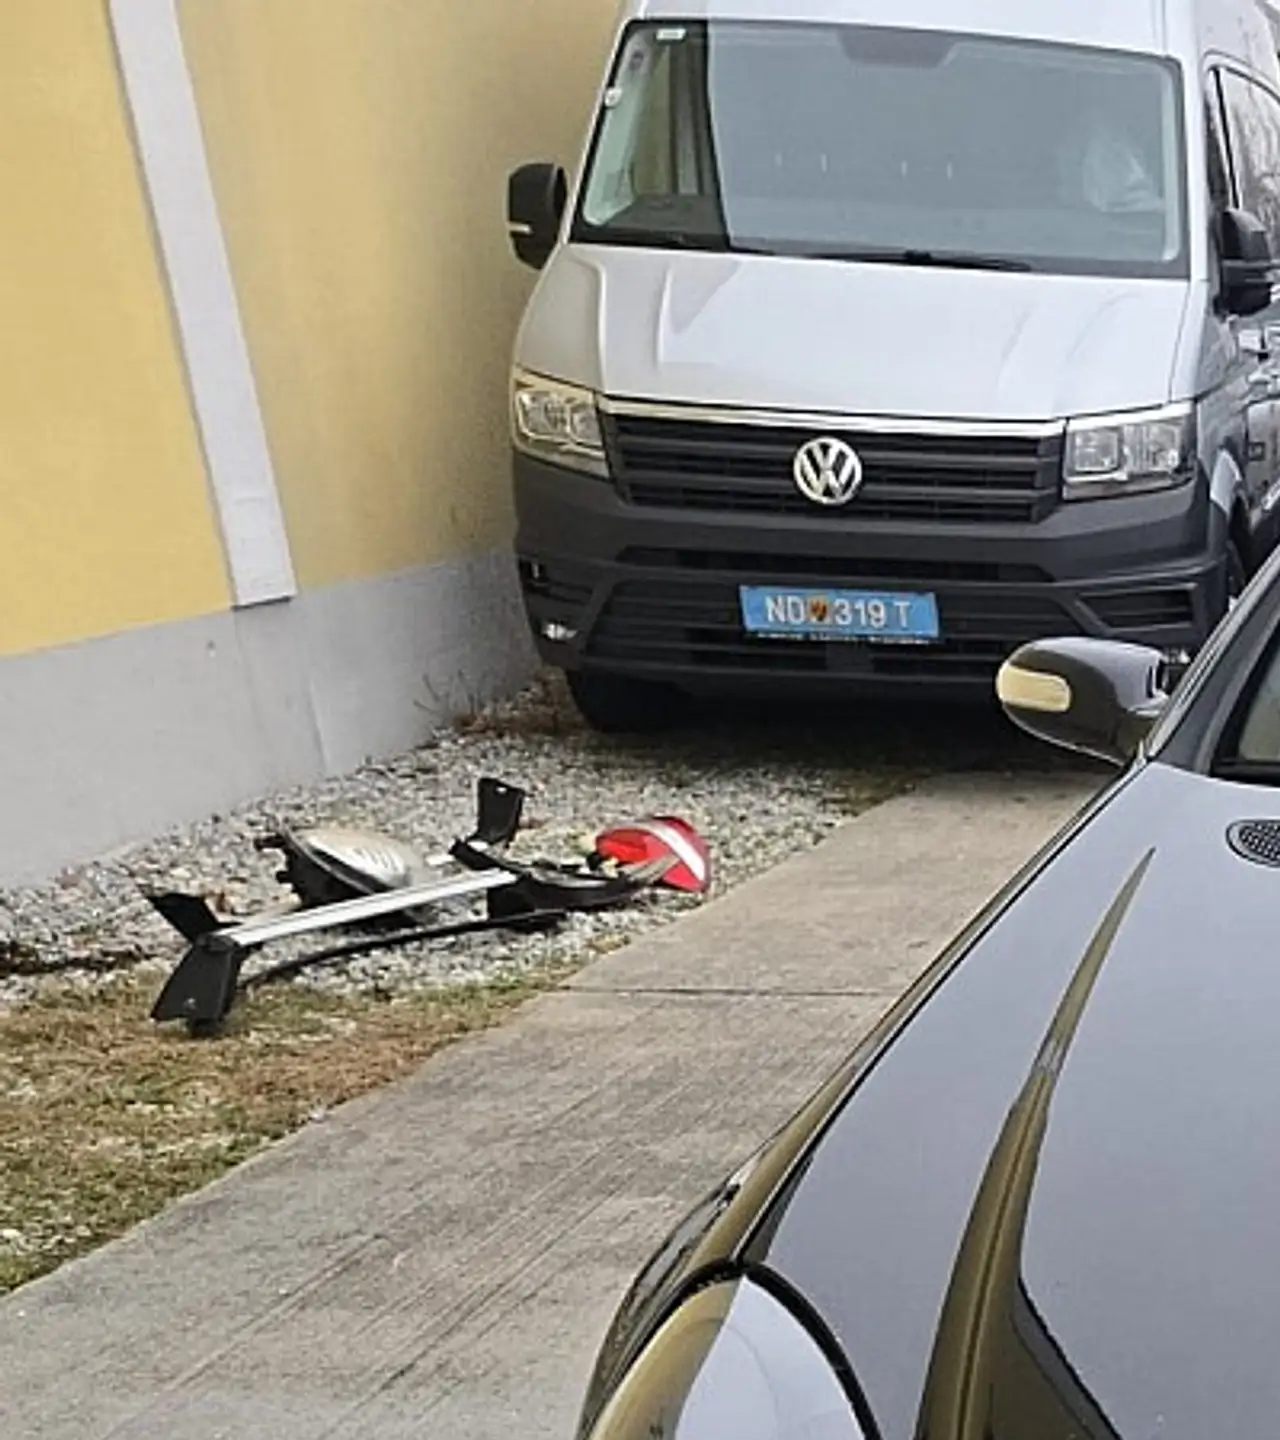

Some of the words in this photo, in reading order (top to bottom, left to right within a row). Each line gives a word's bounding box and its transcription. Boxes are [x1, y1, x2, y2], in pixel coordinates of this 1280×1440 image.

[765, 595, 804, 623] ND
[834, 599, 886, 628] 319
[893, 600, 911, 628] T
